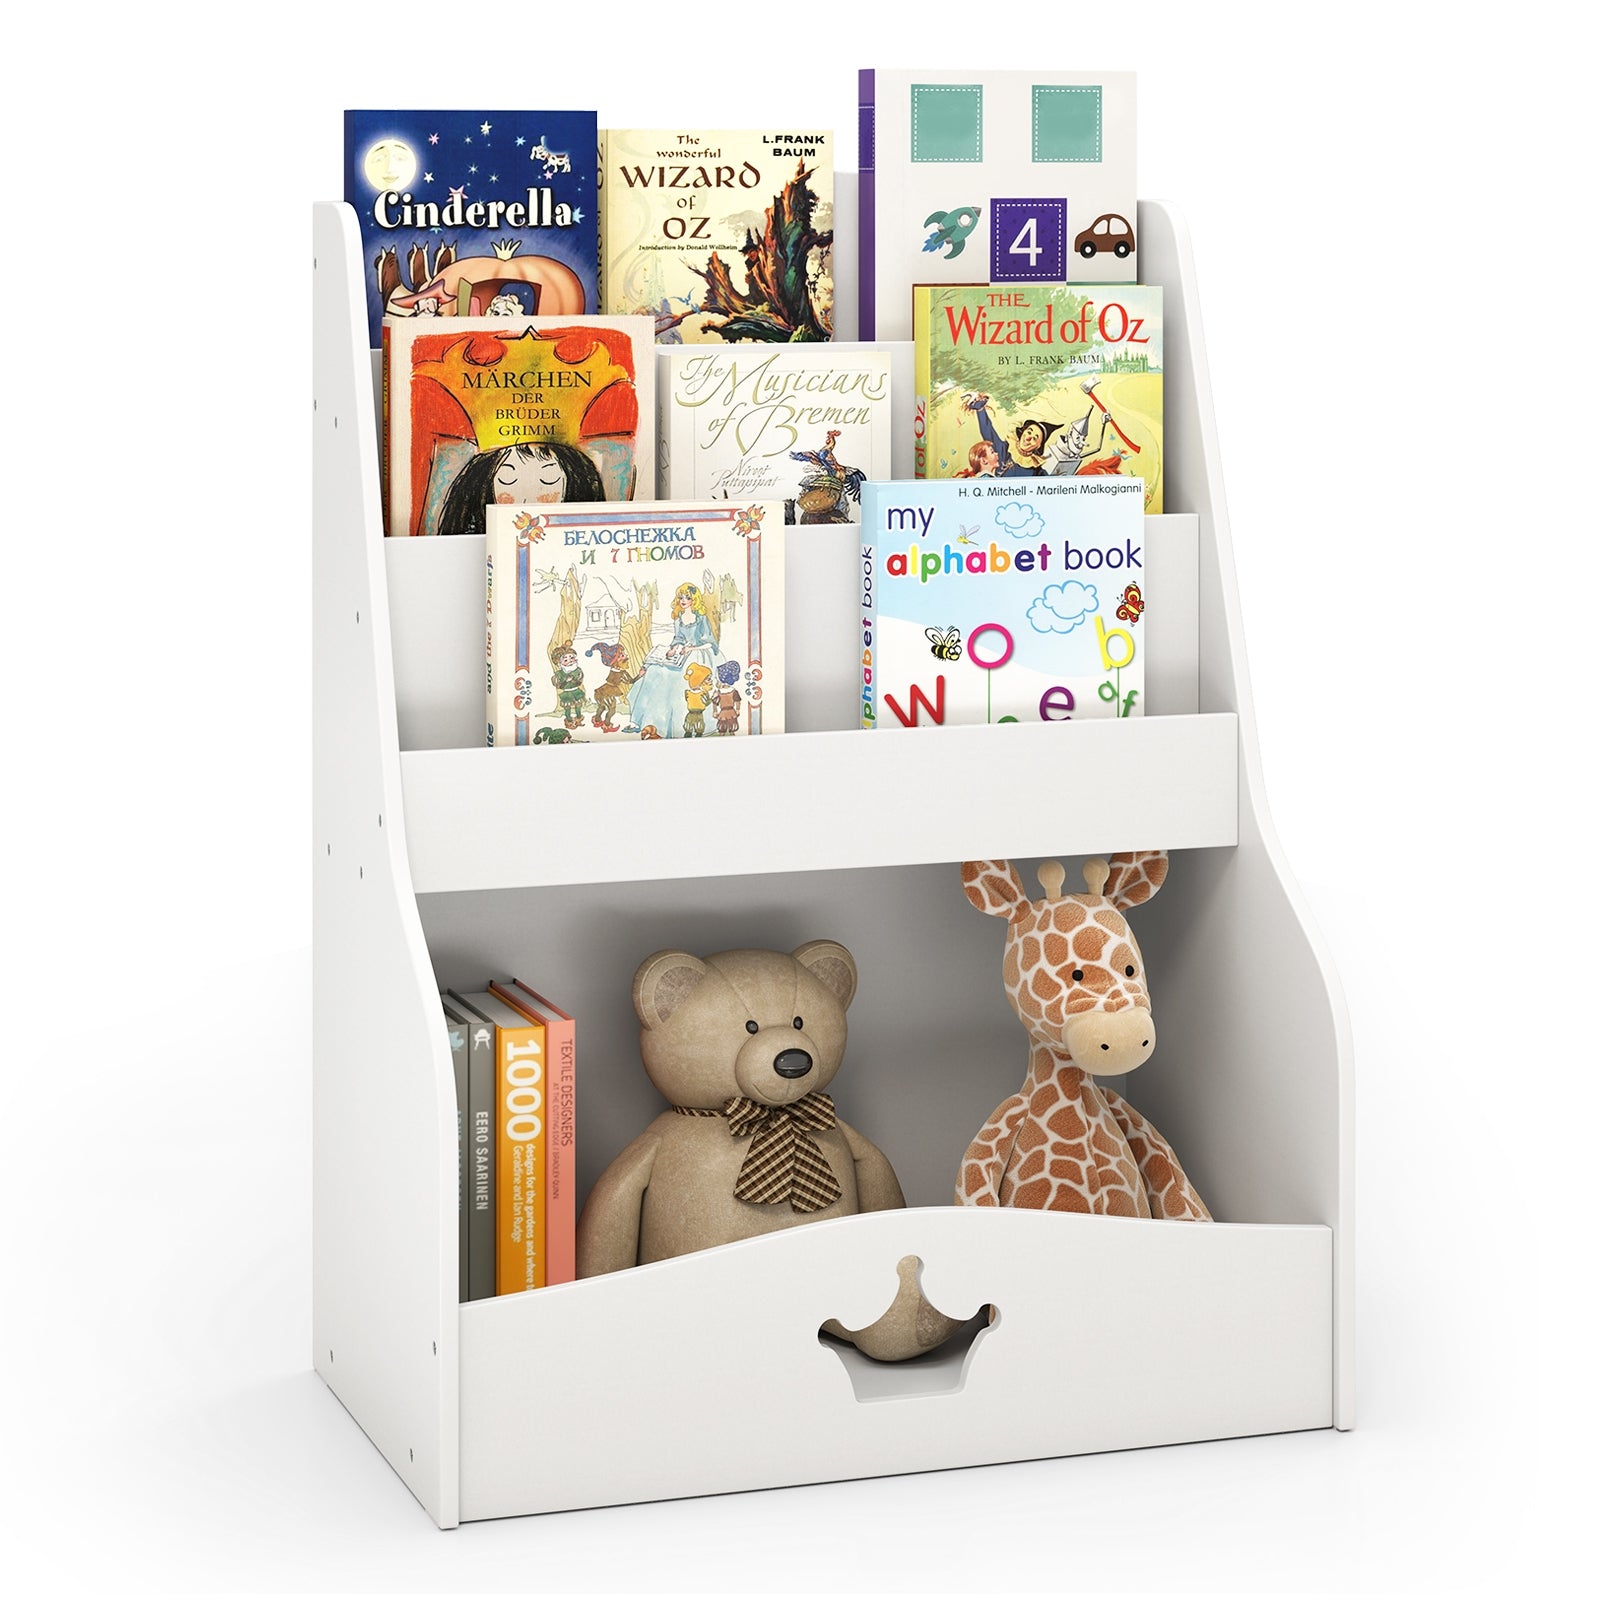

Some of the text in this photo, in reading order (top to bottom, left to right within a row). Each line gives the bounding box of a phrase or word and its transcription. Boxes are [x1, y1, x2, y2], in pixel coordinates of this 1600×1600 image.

[677, 135, 700, 145] The
[762, 135, 825, 144] L.FRANK
[656, 148, 721, 159] wonderful
[773, 148, 816, 157] BAUM
[374, 187, 573, 229] Cinderella
[677, 195, 696, 210] of
[662, 216, 712, 240] OZ
[677, 244, 685, 252] by
[1009, 218, 1043, 267] 4
[986, 293, 1031, 308] THE
[944, 302, 1151, 346] Wizard of Oz
[998, 354, 1100, 366] BY L. FRANK BAUM
[462, 368, 592, 389] MÄRCHEN
[675, 353, 888, 407] Musicians
[680, 354, 725, 395] The
[511, 392, 544, 404] DER
[495, 407, 561, 420] BRÜDER
[914, 400, 926, 439] Oz
[498, 425, 556, 436] GRIMM
[700, 395, 870, 458] of Bremen
[959, 488, 970, 498] H.
[973, 488, 984, 498] Q.
[987, 486, 1027, 497] Mitchell
[1036, 485, 1078, 495] Marileni
[1080, 484, 1142, 496] Malkogianni
[887, 507, 934, 537] my
[563, 526, 696, 547] БЕЛОСНЕЖКА
[580, 544, 705, 565] И 7 ГНОМОВ
[886, 538, 1142, 583] alphabet book
[862, 546, 875, 728] lphabet book
[507, 1040, 541, 1141] 1000
[561, 1038, 573, 1147] TEXTILE DESIGNERS
[476, 1111, 489, 1211] EERO SAARINEN
[513, 1146, 523, 1184] Geraldine
[525, 1143, 536, 1175] designs
[513, 1185, 523, 1200] and
[526, 1176, 536, 1189] for
[526, 1190, 536, 1204] the
[513, 1202, 523, 1215] Ian
[526, 1240, 536, 1256] and
[526, 1257, 536, 1283] where
